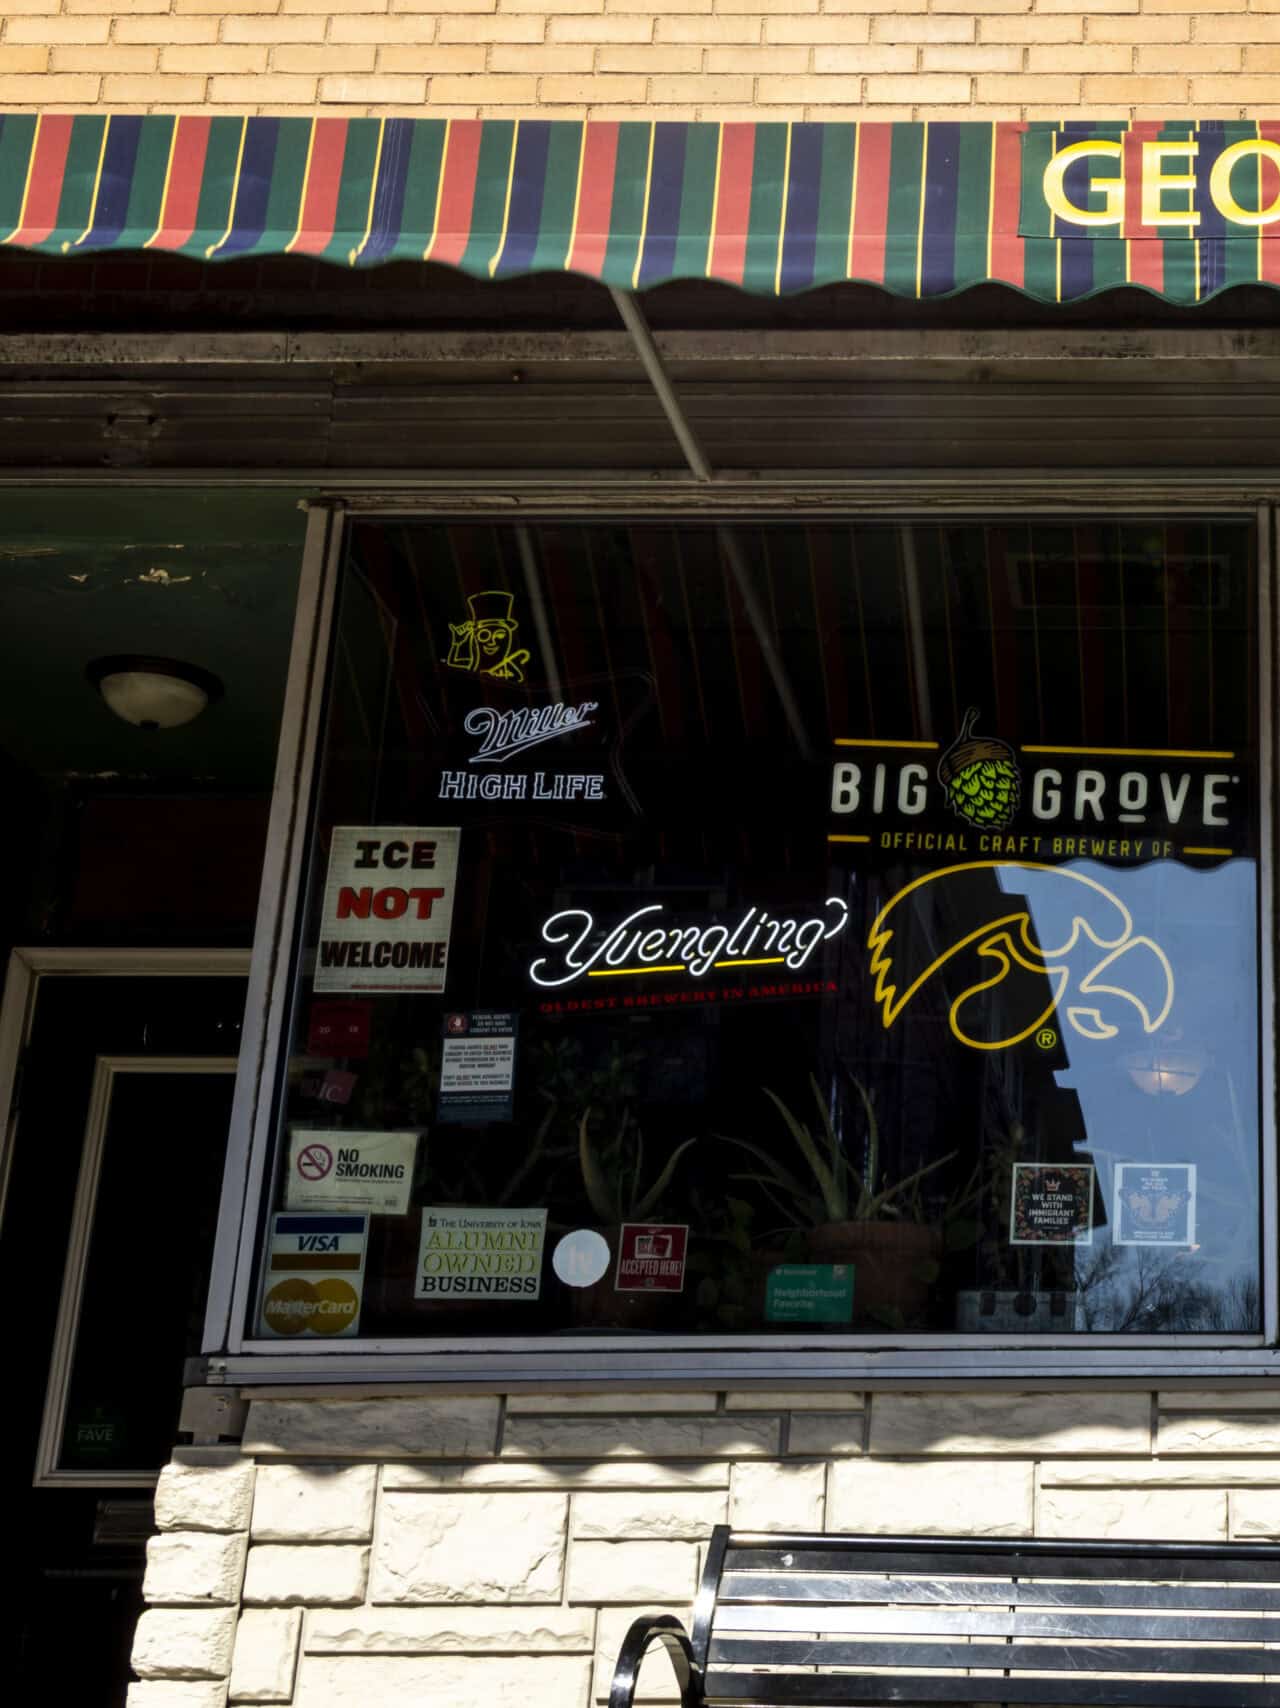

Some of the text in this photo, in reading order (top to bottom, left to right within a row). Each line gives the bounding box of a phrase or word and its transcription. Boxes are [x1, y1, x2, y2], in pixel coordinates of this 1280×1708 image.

[464, 702, 599, 757] Miller
[438, 770, 605, 800] HIGH LIFE
[830, 762, 1231, 827] BIG GROVE
[353, 840, 438, 869] ICE
[880, 831, 1173, 858] OFFICIAL CRAFT BREWERY OF
[336, 886, 445, 920] NOT
[529, 896, 849, 986] Yuengling
[320, 940, 447, 969] WELCOME
[539, 996, 616, 1014] OLDEST
[723, 986, 745, 1000] IN
[748, 981, 839, 998] AMERICA
[337, 1148, 360, 1163] NO
[335, 1162, 405, 1179] SMOKING
[1028, 1208, 1075, 1217] IMMIGRANT
[1041, 1201, 1063, 1209] WITH
[1034, 1217, 1069, 1225] FAMILIES
[298, 1235, 341, 1252] VISA
[426, 1231, 541, 1251] ALUMNI
[423, 1253, 540, 1274] OWNED
[621, 1258, 660, 1276] ACCEPTED
[421, 1275, 538, 1294] BUSINESS
[266, 1298, 355, 1317] MasterCard
